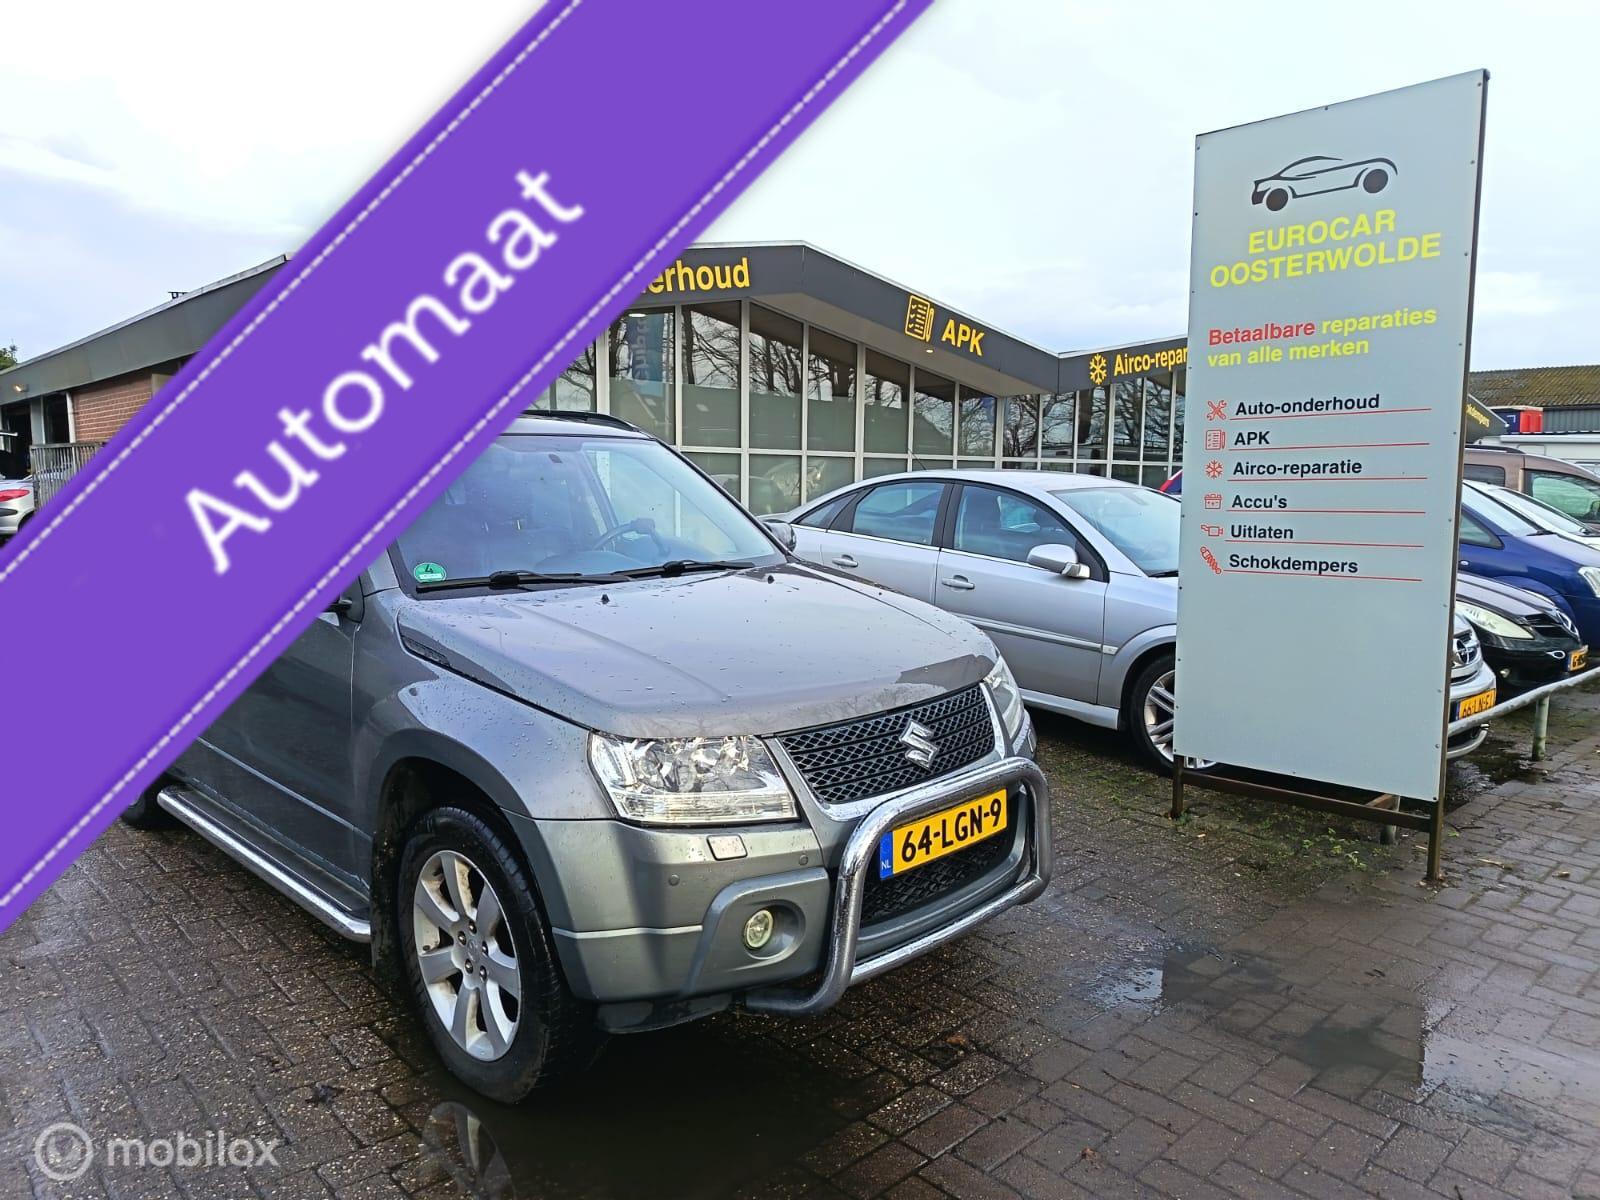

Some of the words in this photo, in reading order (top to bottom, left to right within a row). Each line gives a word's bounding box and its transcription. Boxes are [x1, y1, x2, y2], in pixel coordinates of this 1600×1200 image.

[1248, 208, 1397, 255] EUROCAR
[1209, 231, 1442, 288] OOSTERWOLDE
[642, 257, 750, 294] erhoud
[941, 318, 985, 357] APK
[1208, 321, 1317, 346] Betaalbare
[1320, 307, 1438, 337] reparaties
[1113, 346, 1188, 377] Airco-repar
[1207, 351, 1242, 368] van
[1246, 345, 1283, 364] alle
[1288, 339, 1370, 361] merken
[1234, 394, 1380, 416] Auto-onderhoud
[1233, 430, 1271, 446] APK
[1232, 459, 1363, 479] Airco-reparatie
[1231, 494, 1288, 510] Accu's
[1229, 524, 1294, 540] Uitlaten
[1228, 553, 1359, 575] Schokdempers
[901, 798, 1002, 863] 64-LGN-9
[881, 860, 892, 869] NL
